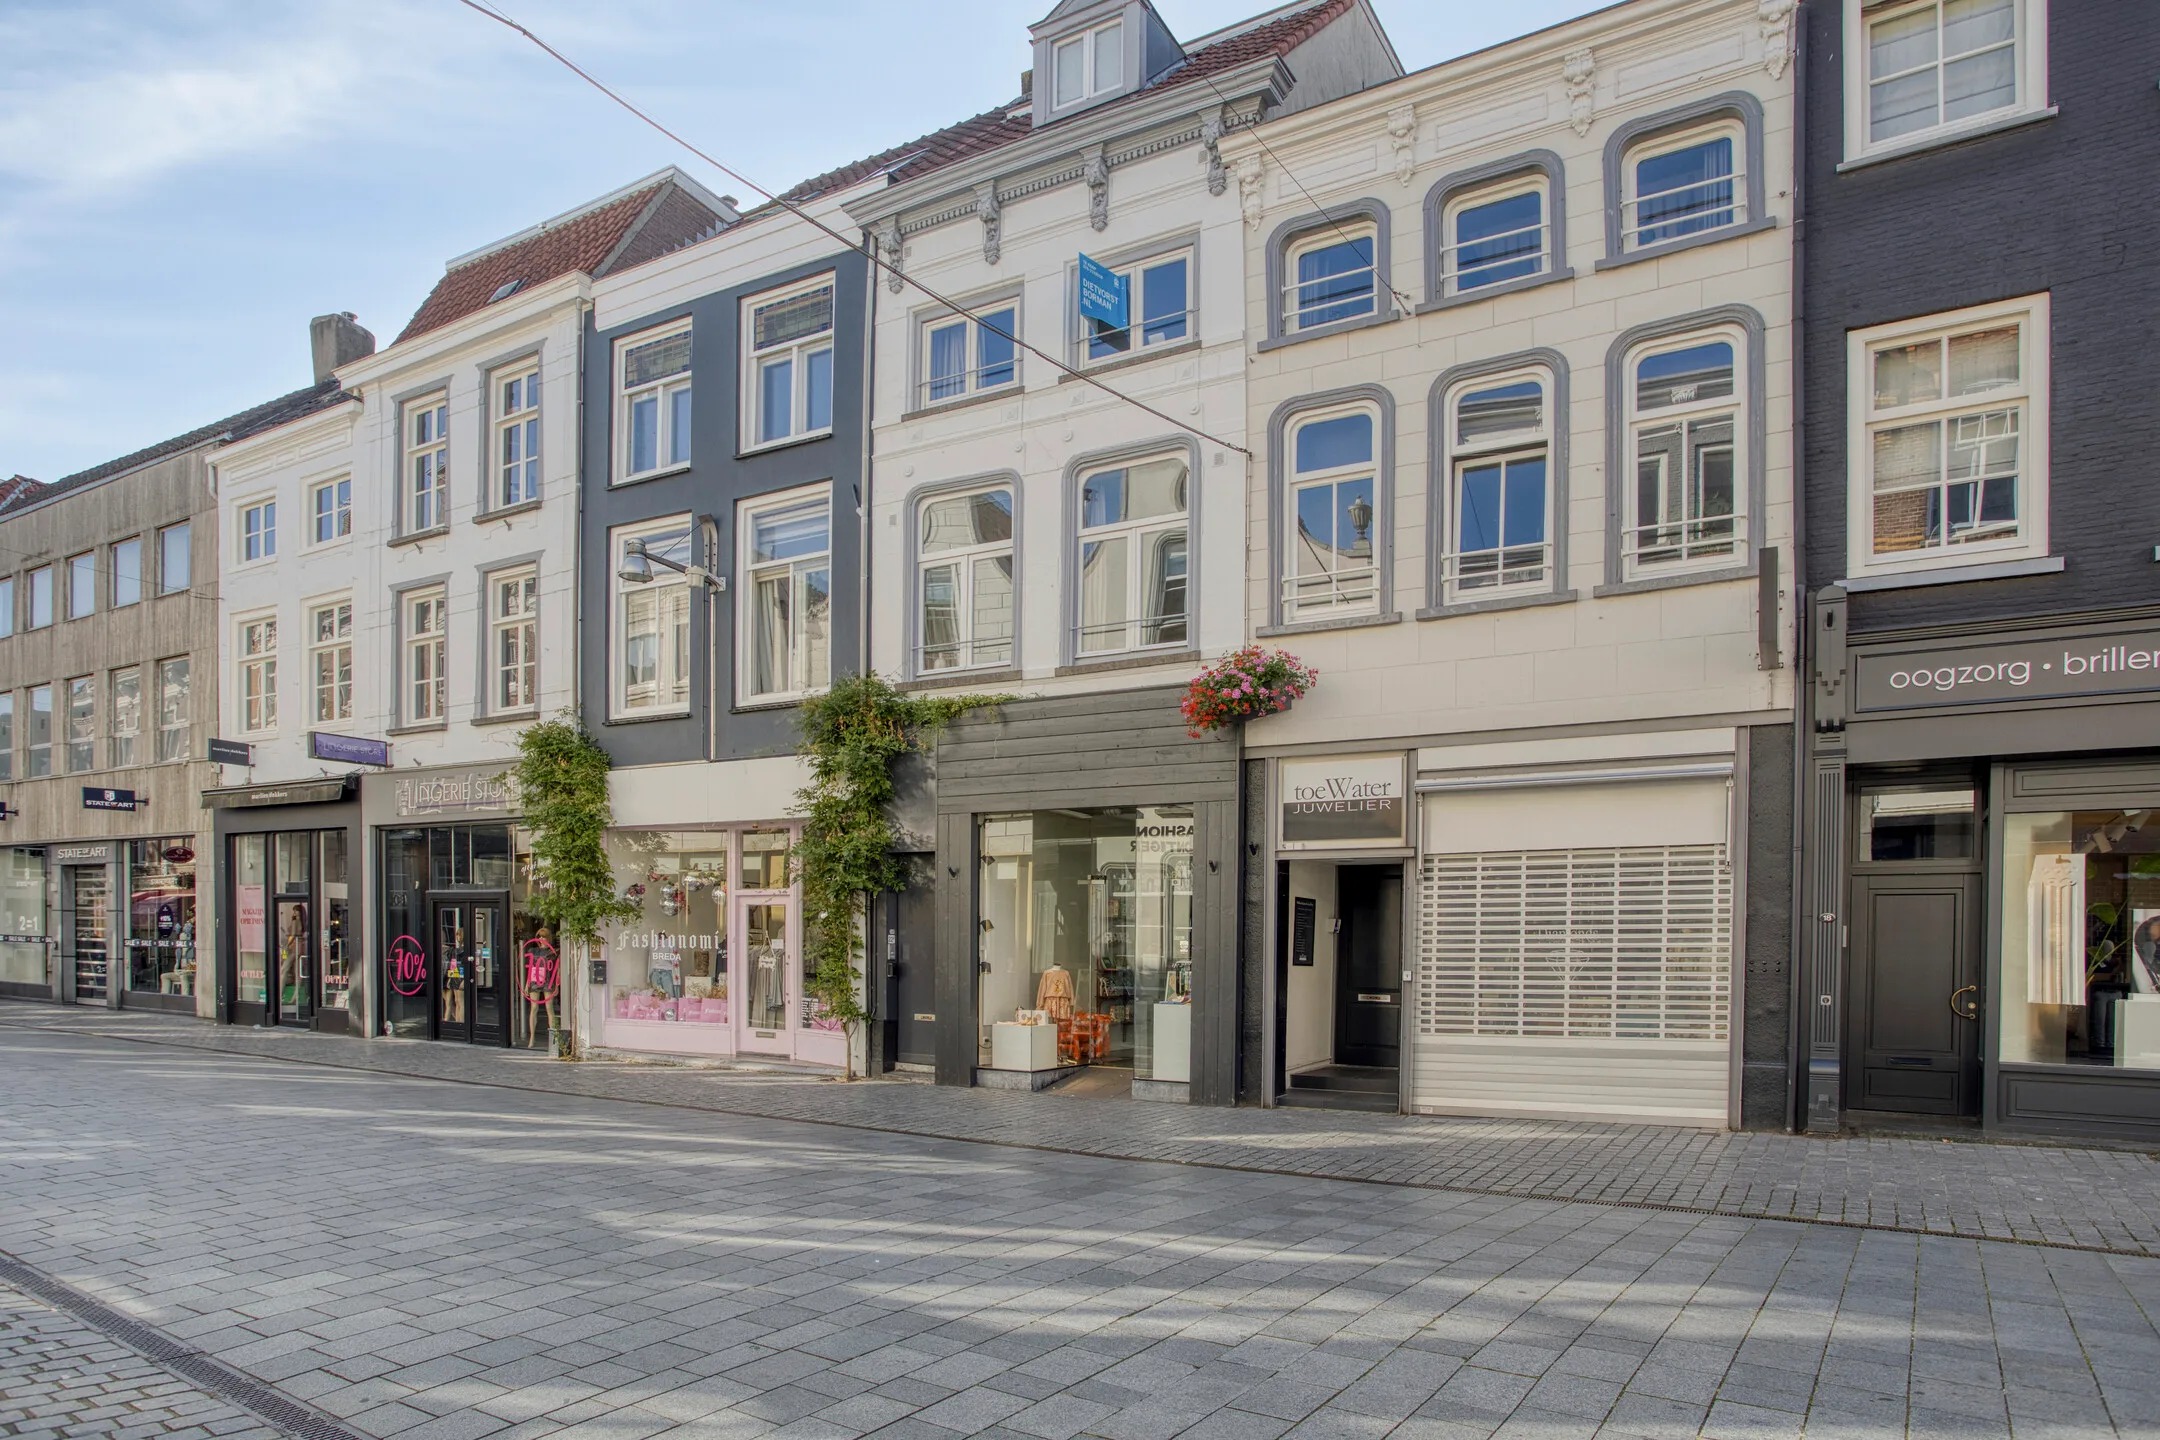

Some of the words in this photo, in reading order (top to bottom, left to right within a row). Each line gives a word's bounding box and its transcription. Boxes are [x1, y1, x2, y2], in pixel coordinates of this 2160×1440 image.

[1083, 278, 1118, 304] DIETVORST
[1083, 288, 1111, 310] BORMAN
[1890, 661, 2031, 691] oogzorg
[1294, 777, 1391, 800] toeWater
[1293, 800, 1391, 814] JUWELIER
[58, 848, 82, 859] STATE
[90, 847, 108, 857] ART
[616, 929, 719, 951] Fashionomi
[652, 952, 681, 961] BREDA
